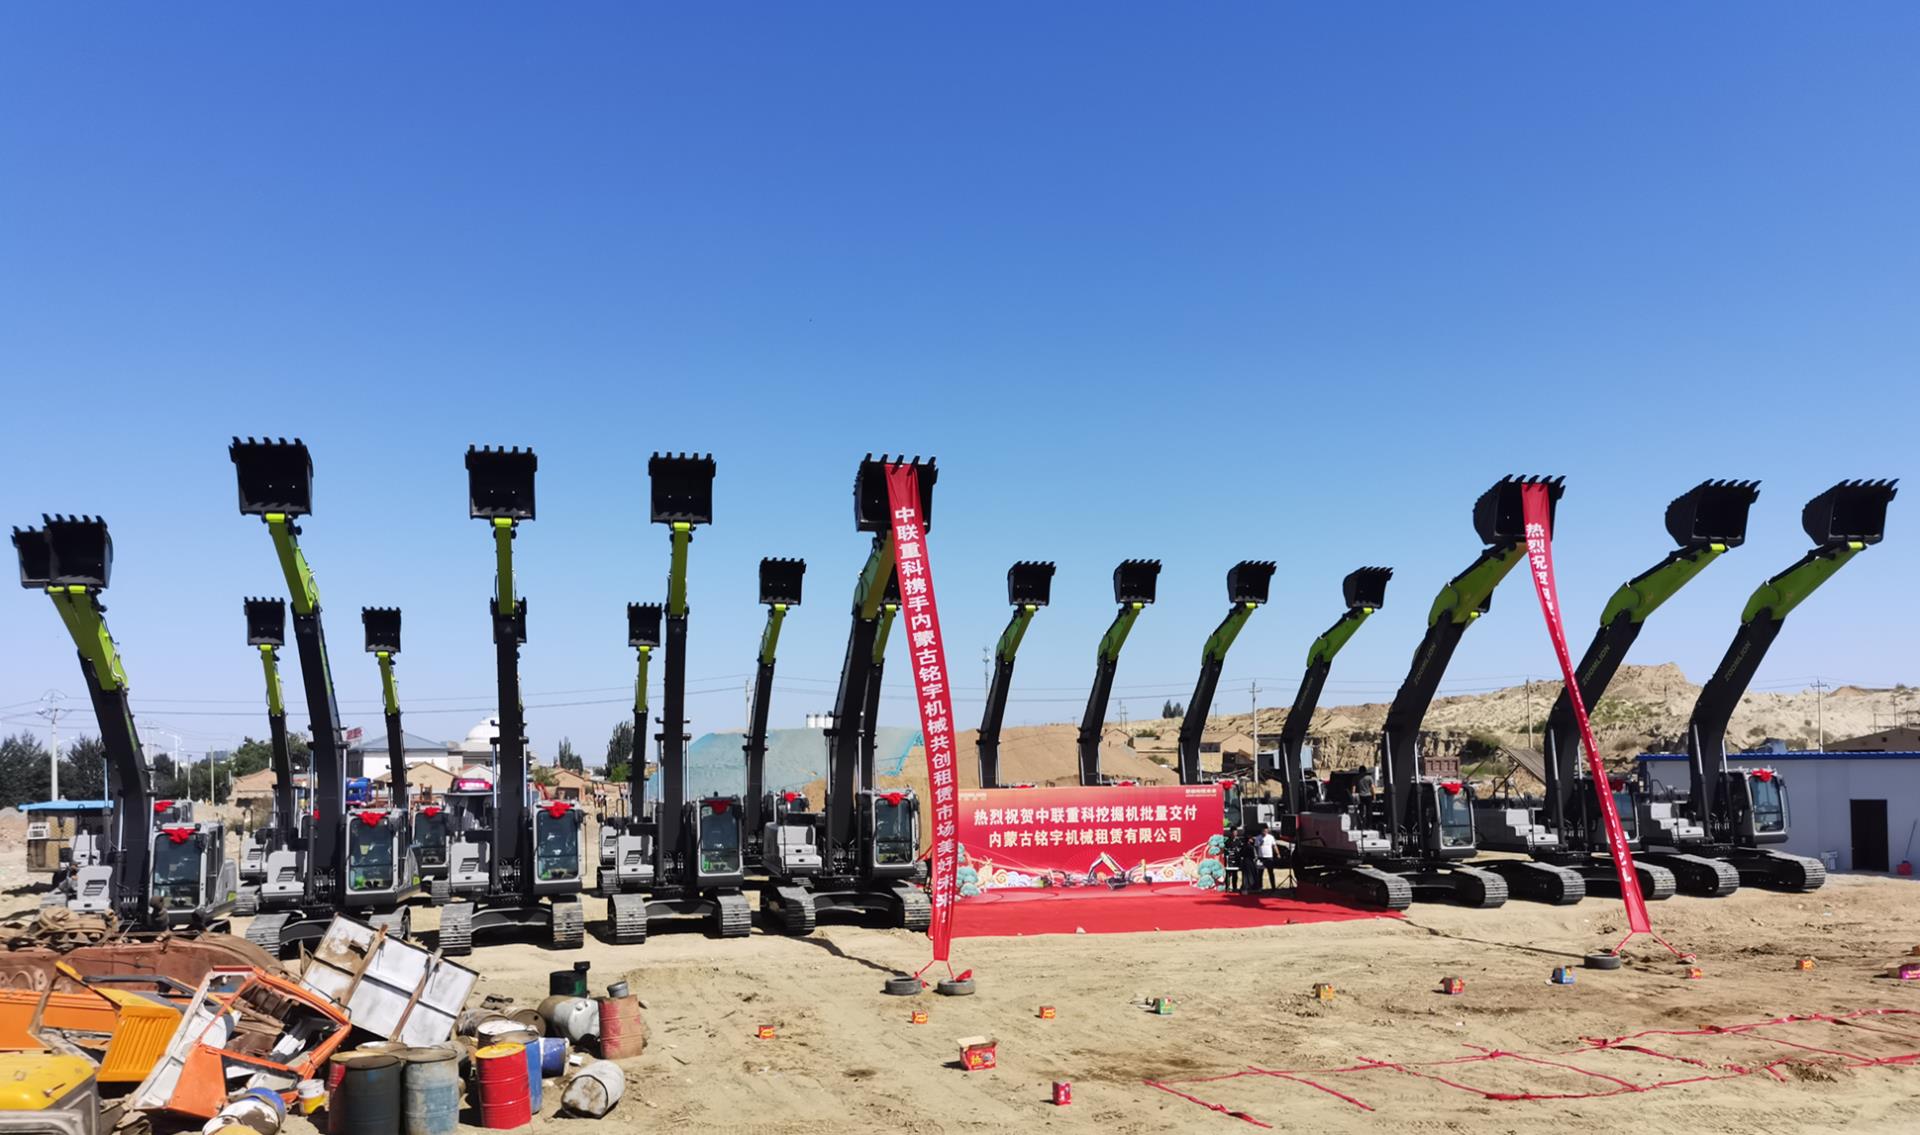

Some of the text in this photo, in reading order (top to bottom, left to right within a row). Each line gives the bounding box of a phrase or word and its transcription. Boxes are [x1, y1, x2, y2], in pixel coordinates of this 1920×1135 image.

[974, 805, 1197, 826] 热烈祝贺中联重科挖掘机批量交付
[989, 827, 1181, 848] 内蒙古铭宇机械租赁有限公司
